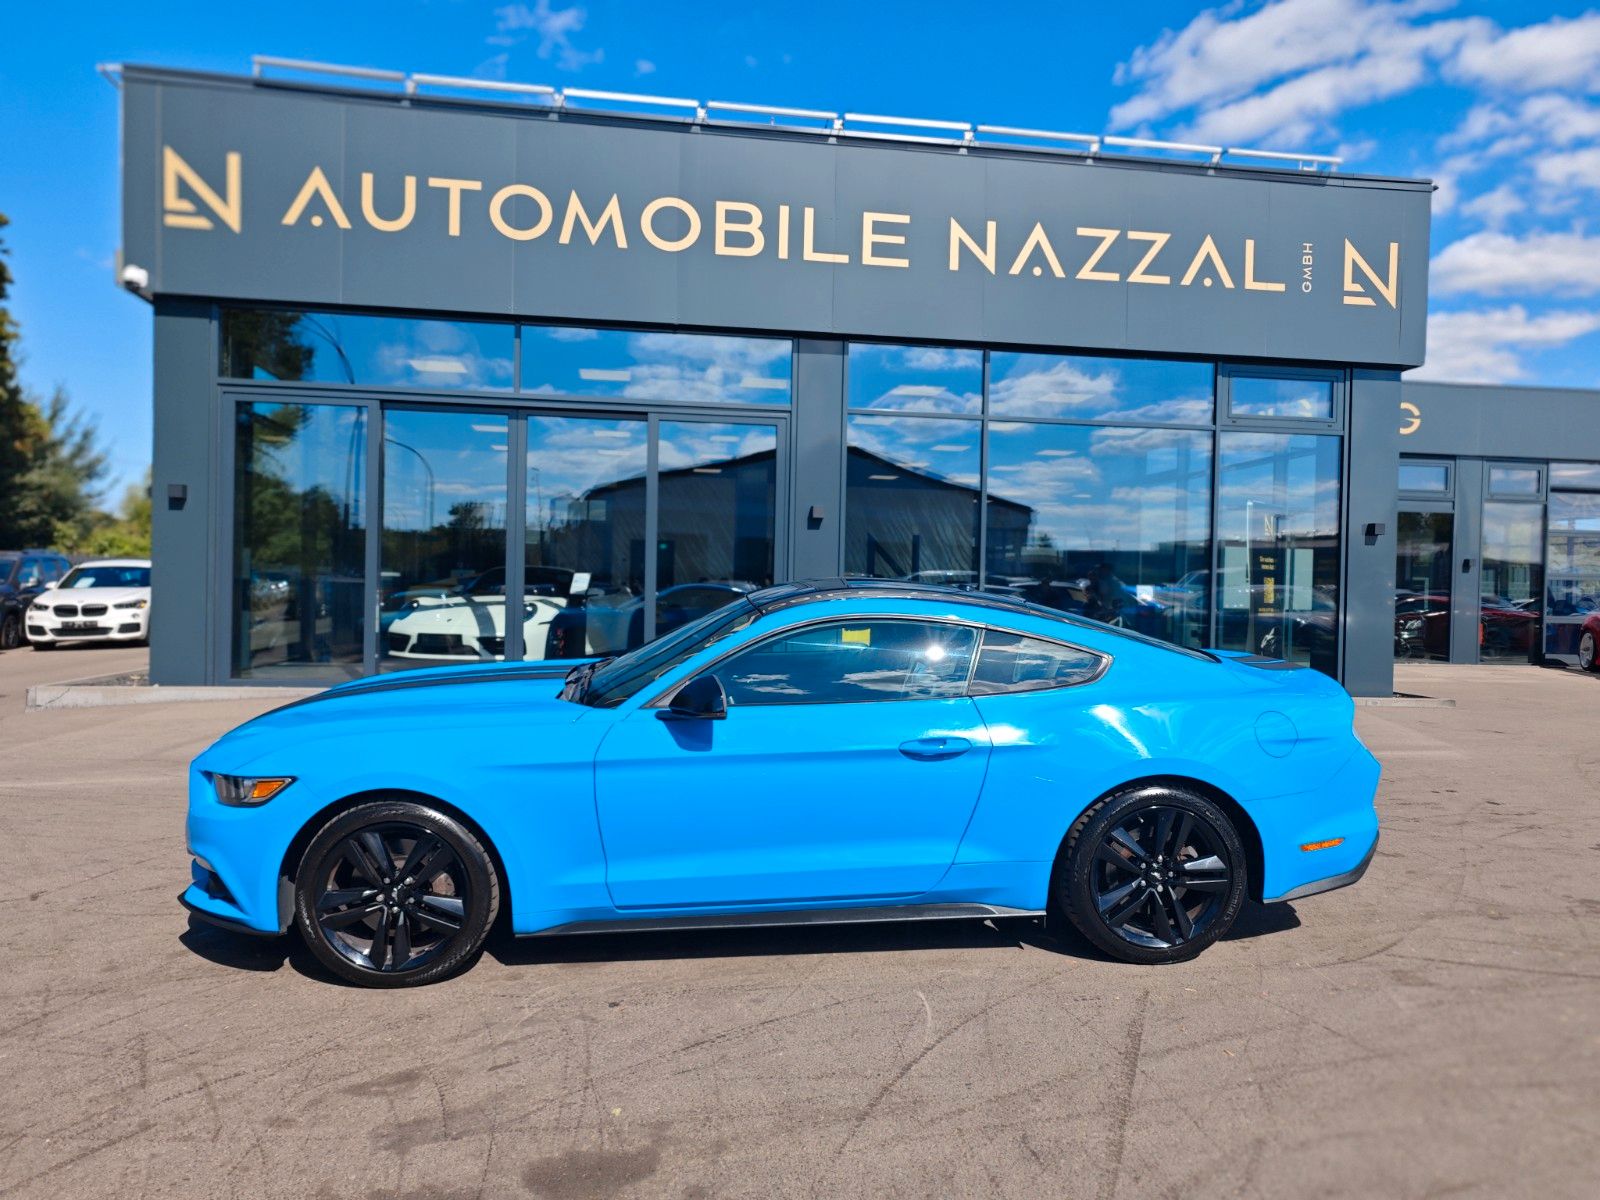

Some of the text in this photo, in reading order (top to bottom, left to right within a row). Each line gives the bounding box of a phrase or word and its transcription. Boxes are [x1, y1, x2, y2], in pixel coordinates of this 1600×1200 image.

[281, 165, 1286, 293] AUTOMOBILE NAZZAL
[1302, 242, 1313, 293] GMBH
